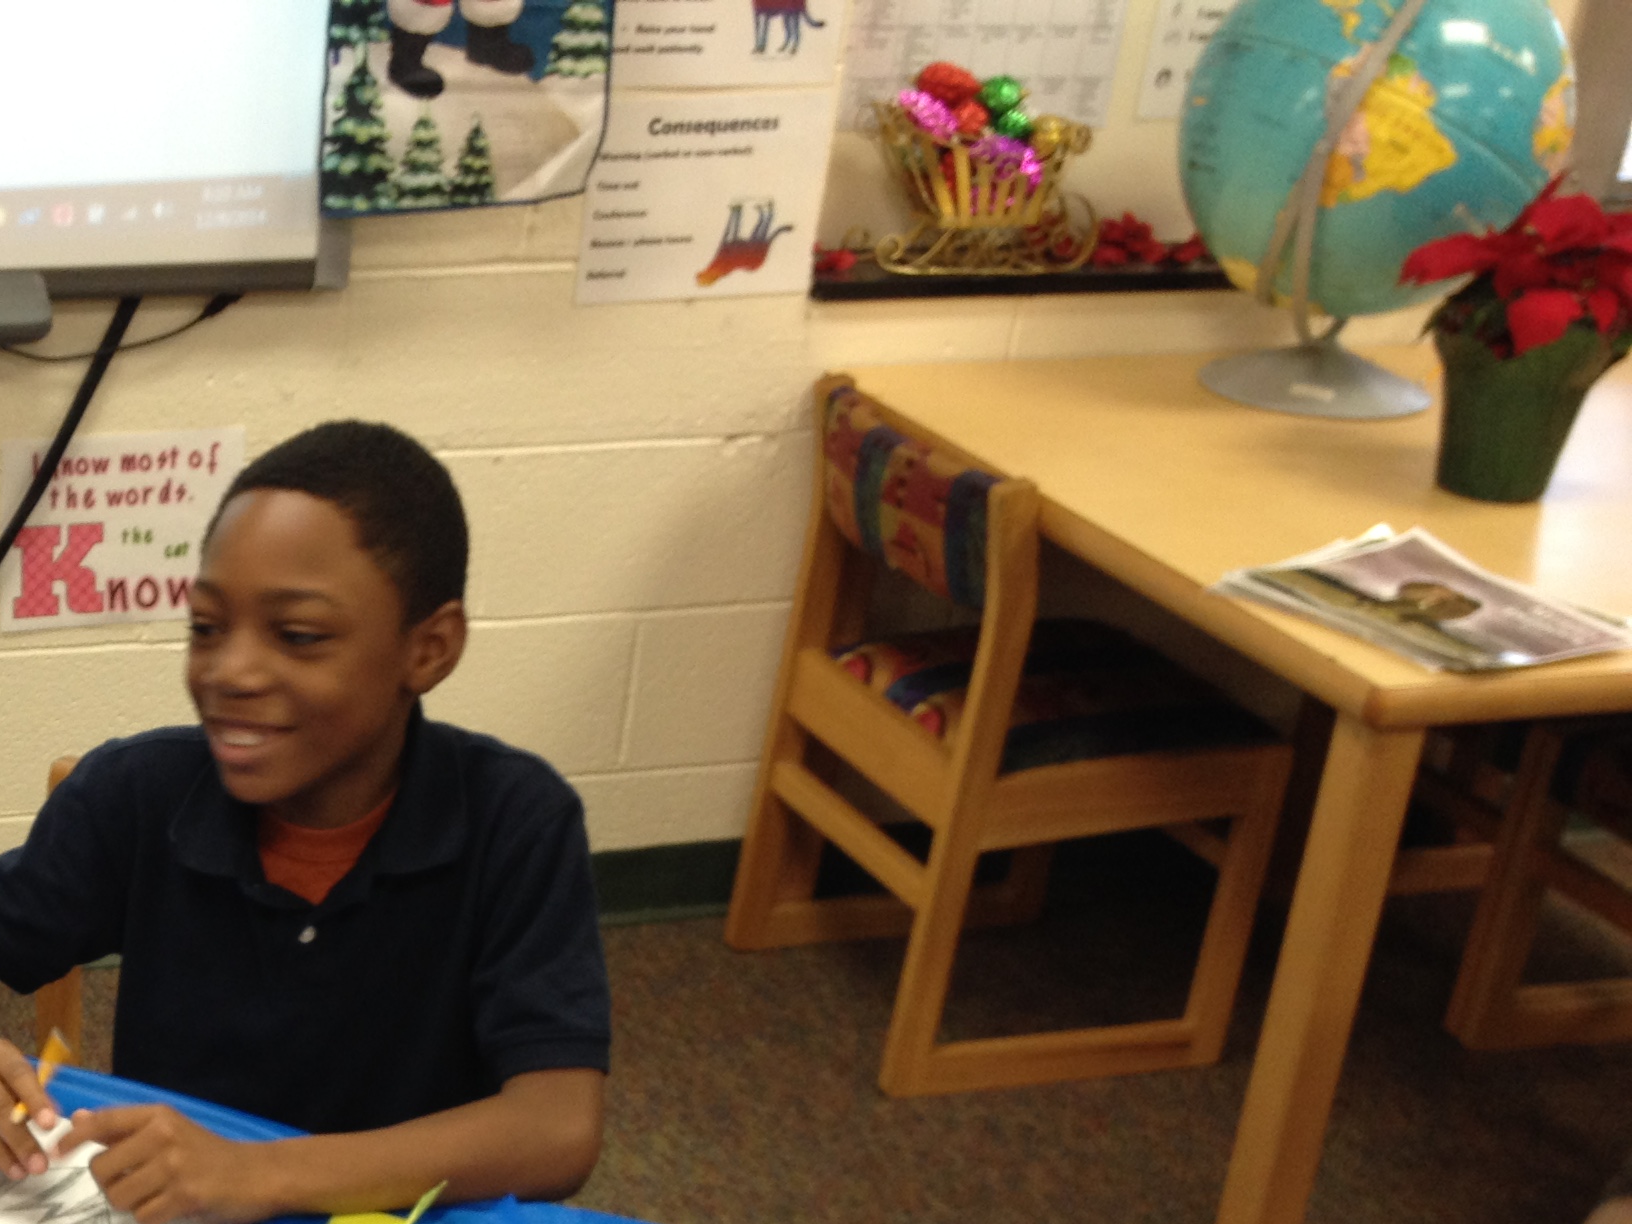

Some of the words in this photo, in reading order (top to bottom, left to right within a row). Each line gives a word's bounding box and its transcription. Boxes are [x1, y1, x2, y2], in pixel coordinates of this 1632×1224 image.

[647, 116, 780, 137] Consequences
[51, 456, 110, 480] now
[120, 446, 179, 474] most
[188, 441, 222, 475] of
[50, 484, 97, 509] the
